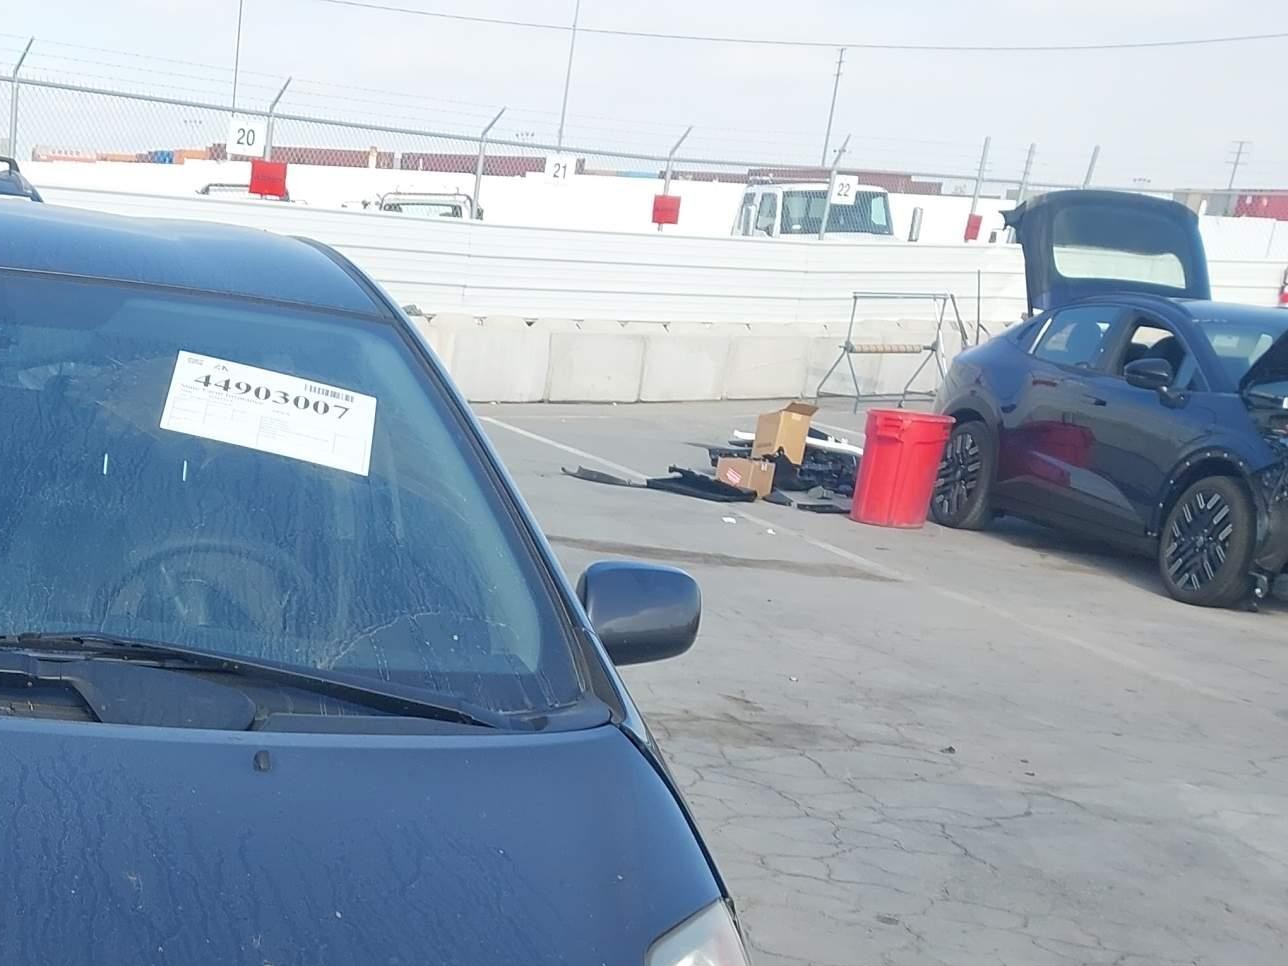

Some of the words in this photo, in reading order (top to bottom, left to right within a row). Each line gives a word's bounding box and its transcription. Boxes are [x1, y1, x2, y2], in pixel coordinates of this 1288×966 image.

[237, 128, 256, 146] 20
[553, 163, 567, 179] 21
[837, 182, 851, 197] 22
[193, 374, 351, 419] 44903007
